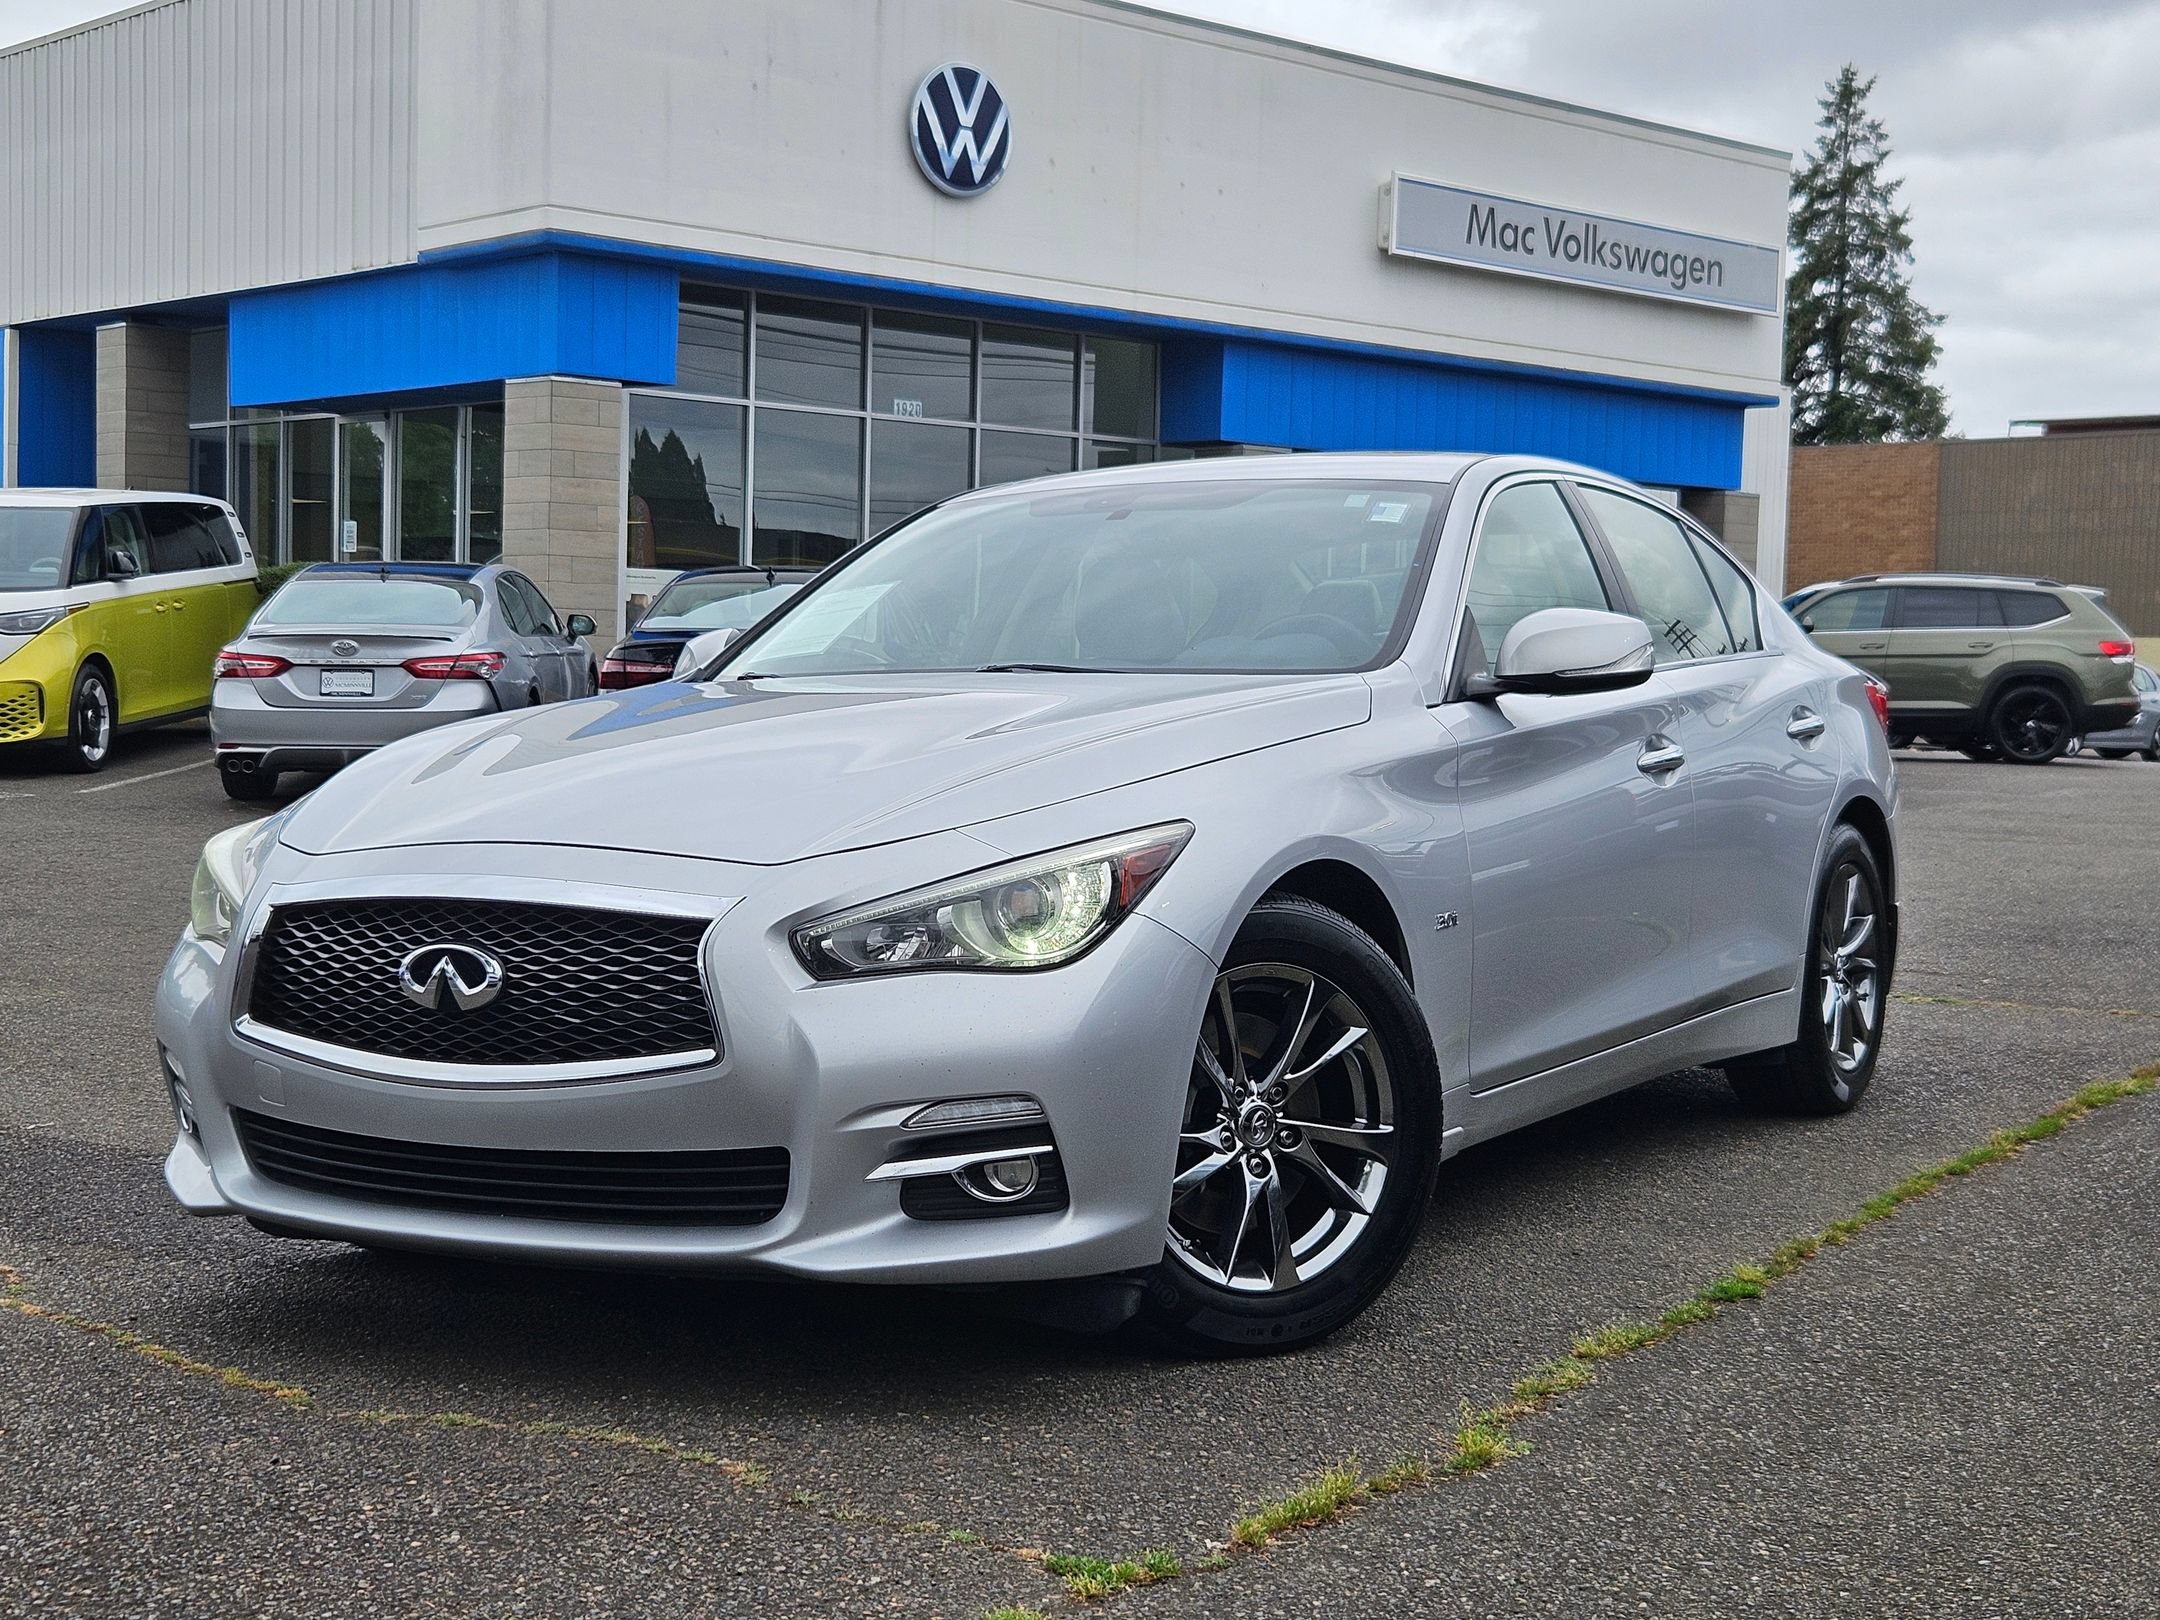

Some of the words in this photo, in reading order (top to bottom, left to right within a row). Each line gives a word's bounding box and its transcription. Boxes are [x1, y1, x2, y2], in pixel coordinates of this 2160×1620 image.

[913, 64, 1010, 188] VW
[1465, 202, 1535, 256] Mac
[1542, 216, 1723, 291] Volkswagen
[895, 401, 922, 417] 1920
